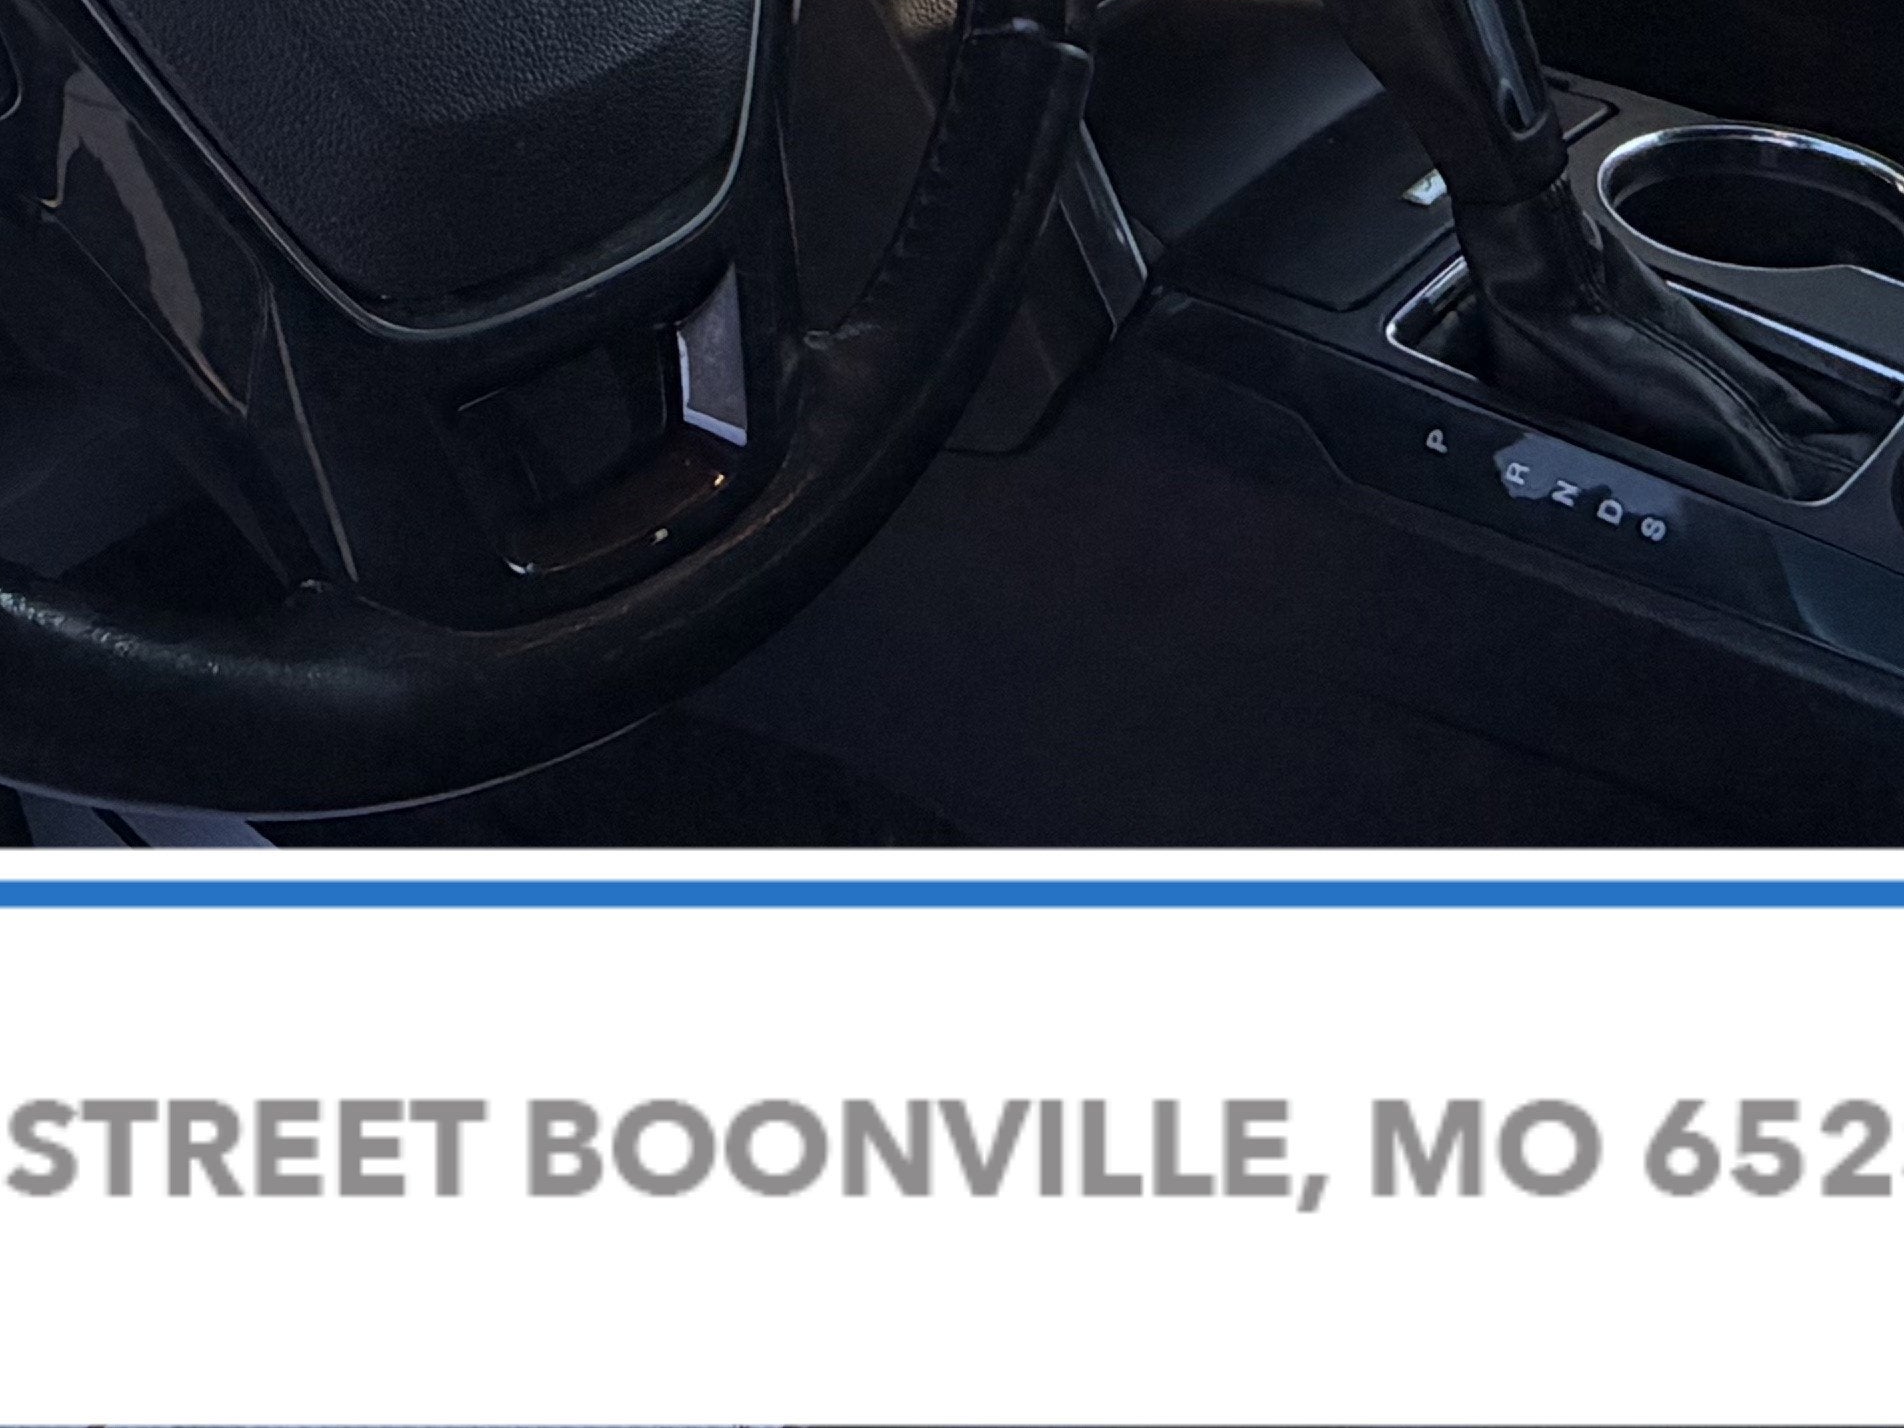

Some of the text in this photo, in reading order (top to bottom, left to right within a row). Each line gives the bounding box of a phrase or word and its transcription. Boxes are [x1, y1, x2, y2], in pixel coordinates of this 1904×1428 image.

[1426, 428, 1667, 543] P R N D S
